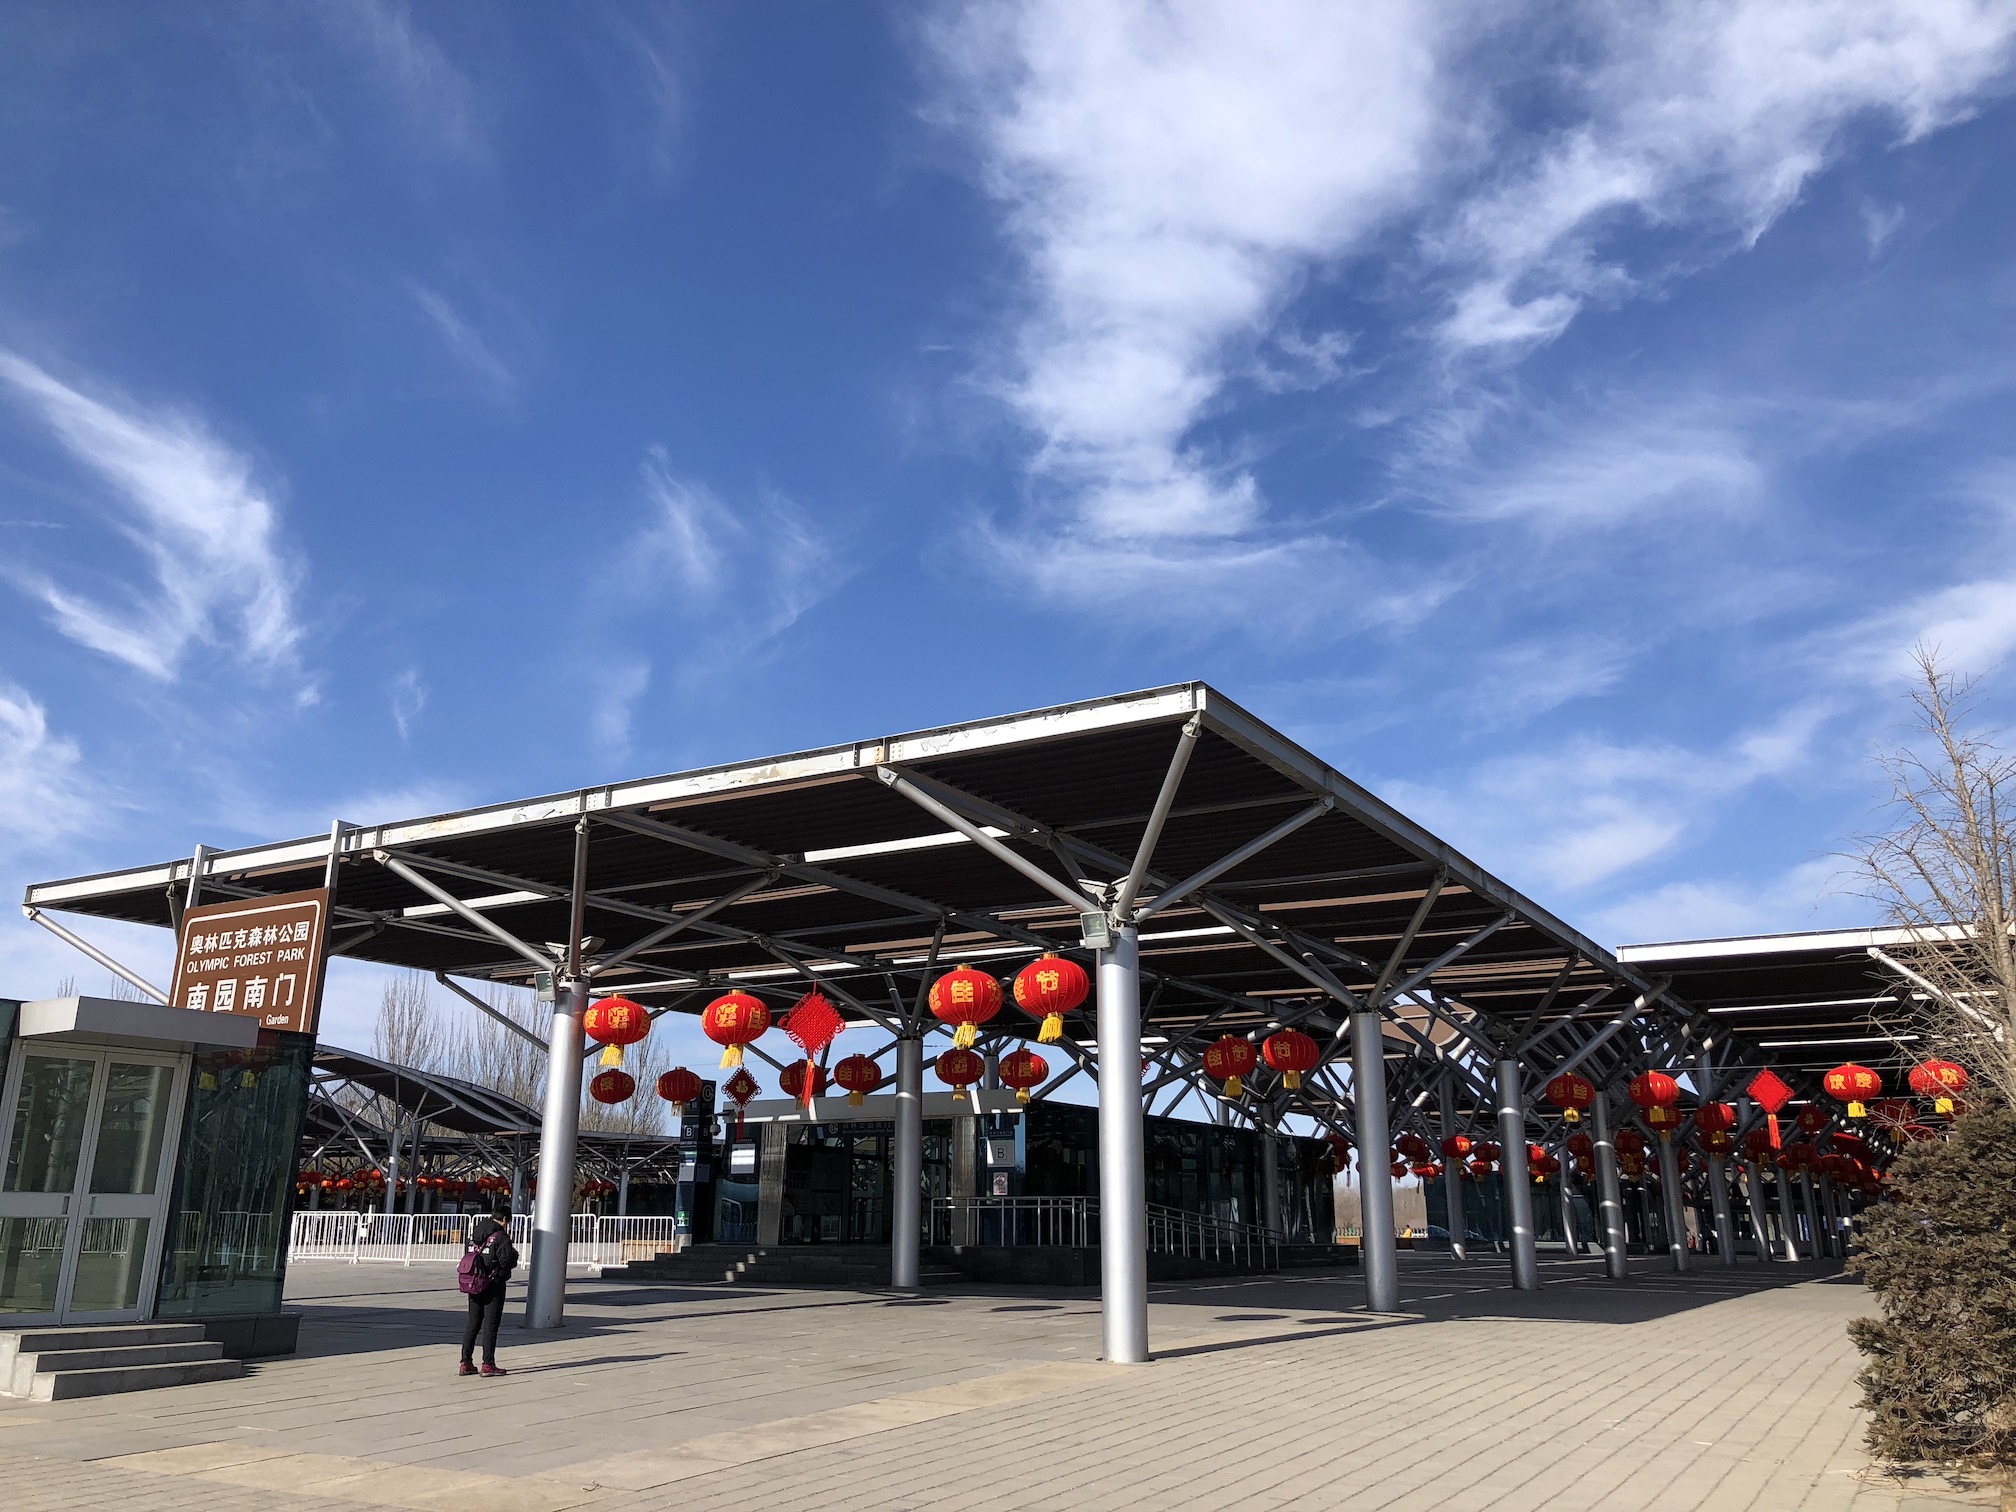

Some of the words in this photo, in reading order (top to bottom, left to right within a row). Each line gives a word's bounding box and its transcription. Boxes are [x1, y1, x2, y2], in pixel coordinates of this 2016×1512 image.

[189, 920, 310, 956] 奥林匹克森林公园
[187, 956, 230, 974] OLYMPIC
[233, 951, 273, 968] FOREST
[276, 946, 306, 963] PARK
[186, 972, 297, 1012] 南园南门
[266, 1014, 289, 1026] Garden
[686, 1127, 692, 1137] B
[702, 1127, 709, 1137] B
[997, 1147, 1005, 1159] B
